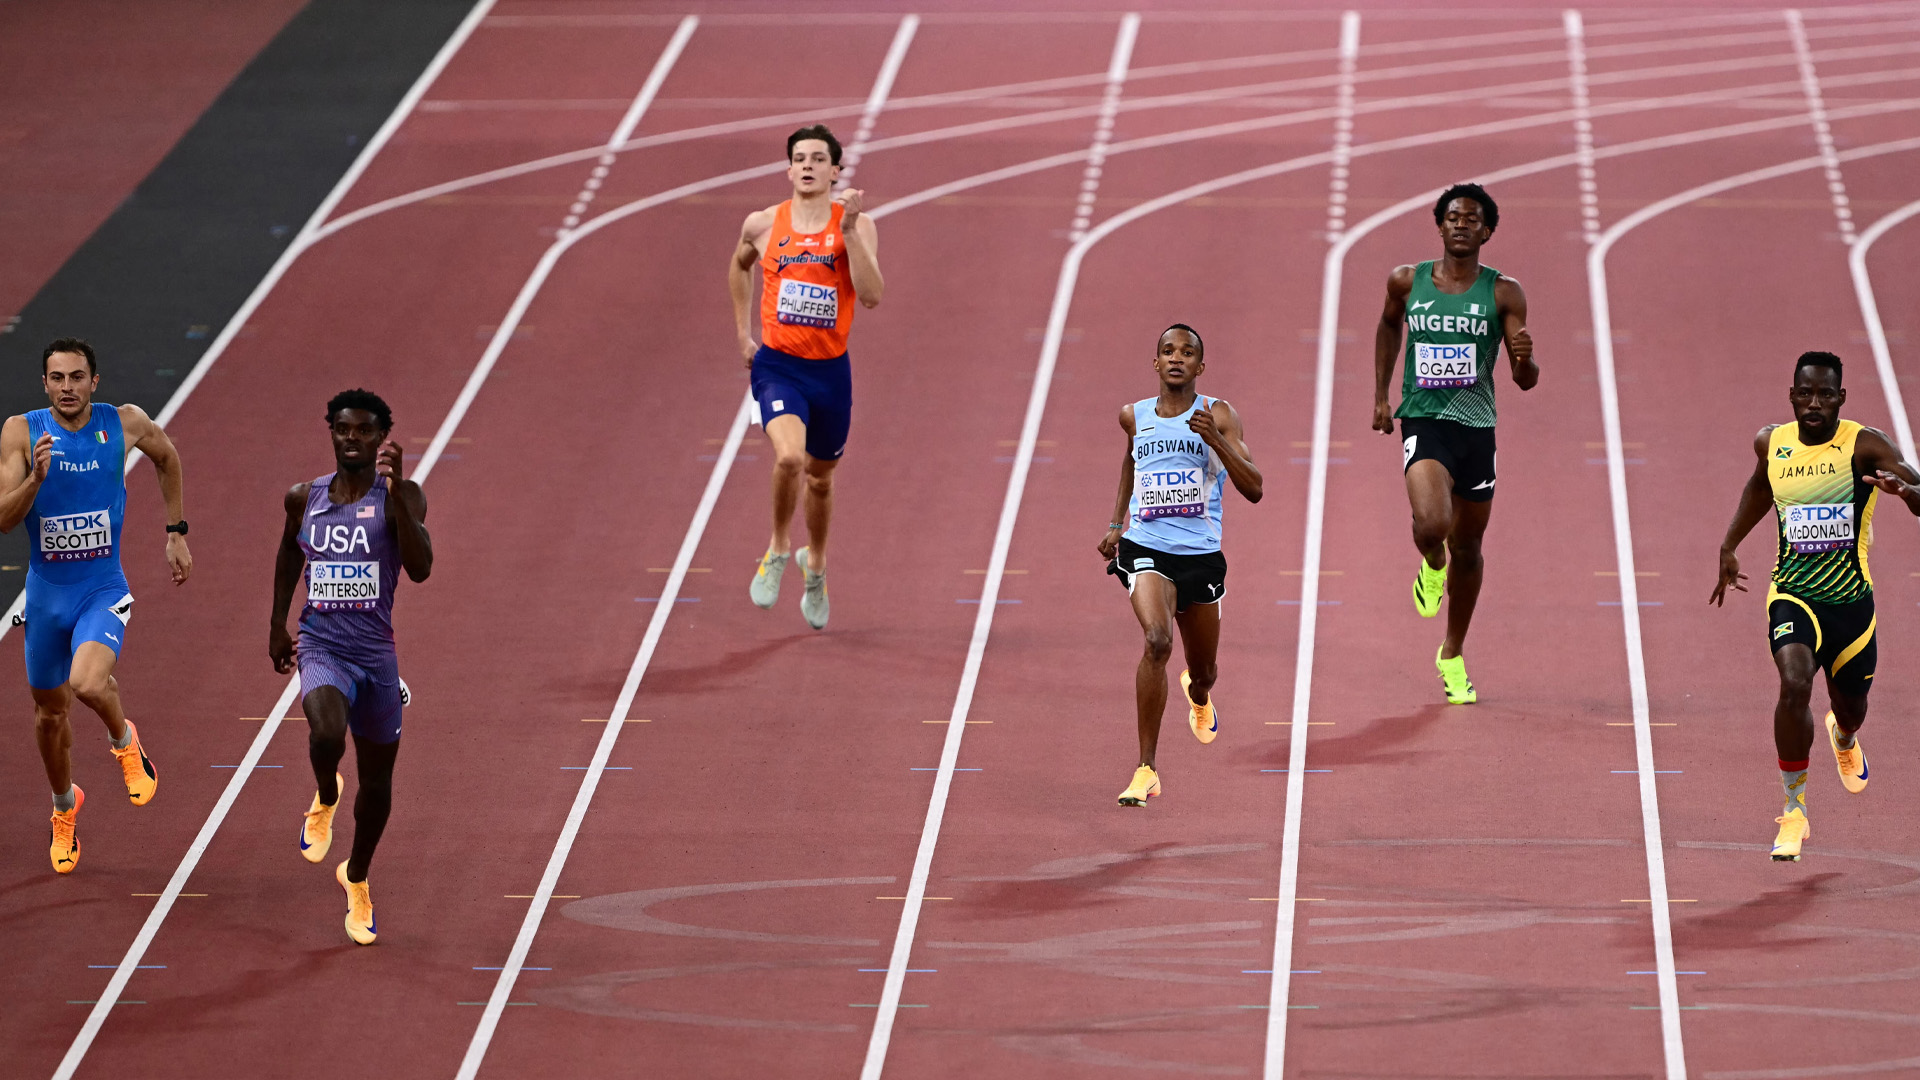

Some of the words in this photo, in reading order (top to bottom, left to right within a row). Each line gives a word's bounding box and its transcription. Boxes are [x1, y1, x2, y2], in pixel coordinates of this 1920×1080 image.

[797, 284, 836, 301] TDK
[781, 297, 836, 317] PHIJFFERS
[1408, 314, 1488, 336] NIGERIA
[1429, 346, 1471, 359] TDK
[1420, 361, 1472, 376] OGAZI
[1137, 439, 1204, 460] BOTSWANA
[60, 460, 100, 473] ITALIA
[1779, 462, 1836, 479] JAMAICA
[1152, 470, 1198, 486] TDK
[1141, 489, 1201, 506] KEBINATSHIPI
[1802, 505, 1848, 521] TDK
[57, 513, 104, 531] TDK
[44, 531, 107, 550] SCOTTI
[310, 524, 371, 554] USA
[1789, 523, 1850, 541] McDONALD
[326, 564, 373, 579] TDK
[313, 582, 377, 598] PATTERSON
